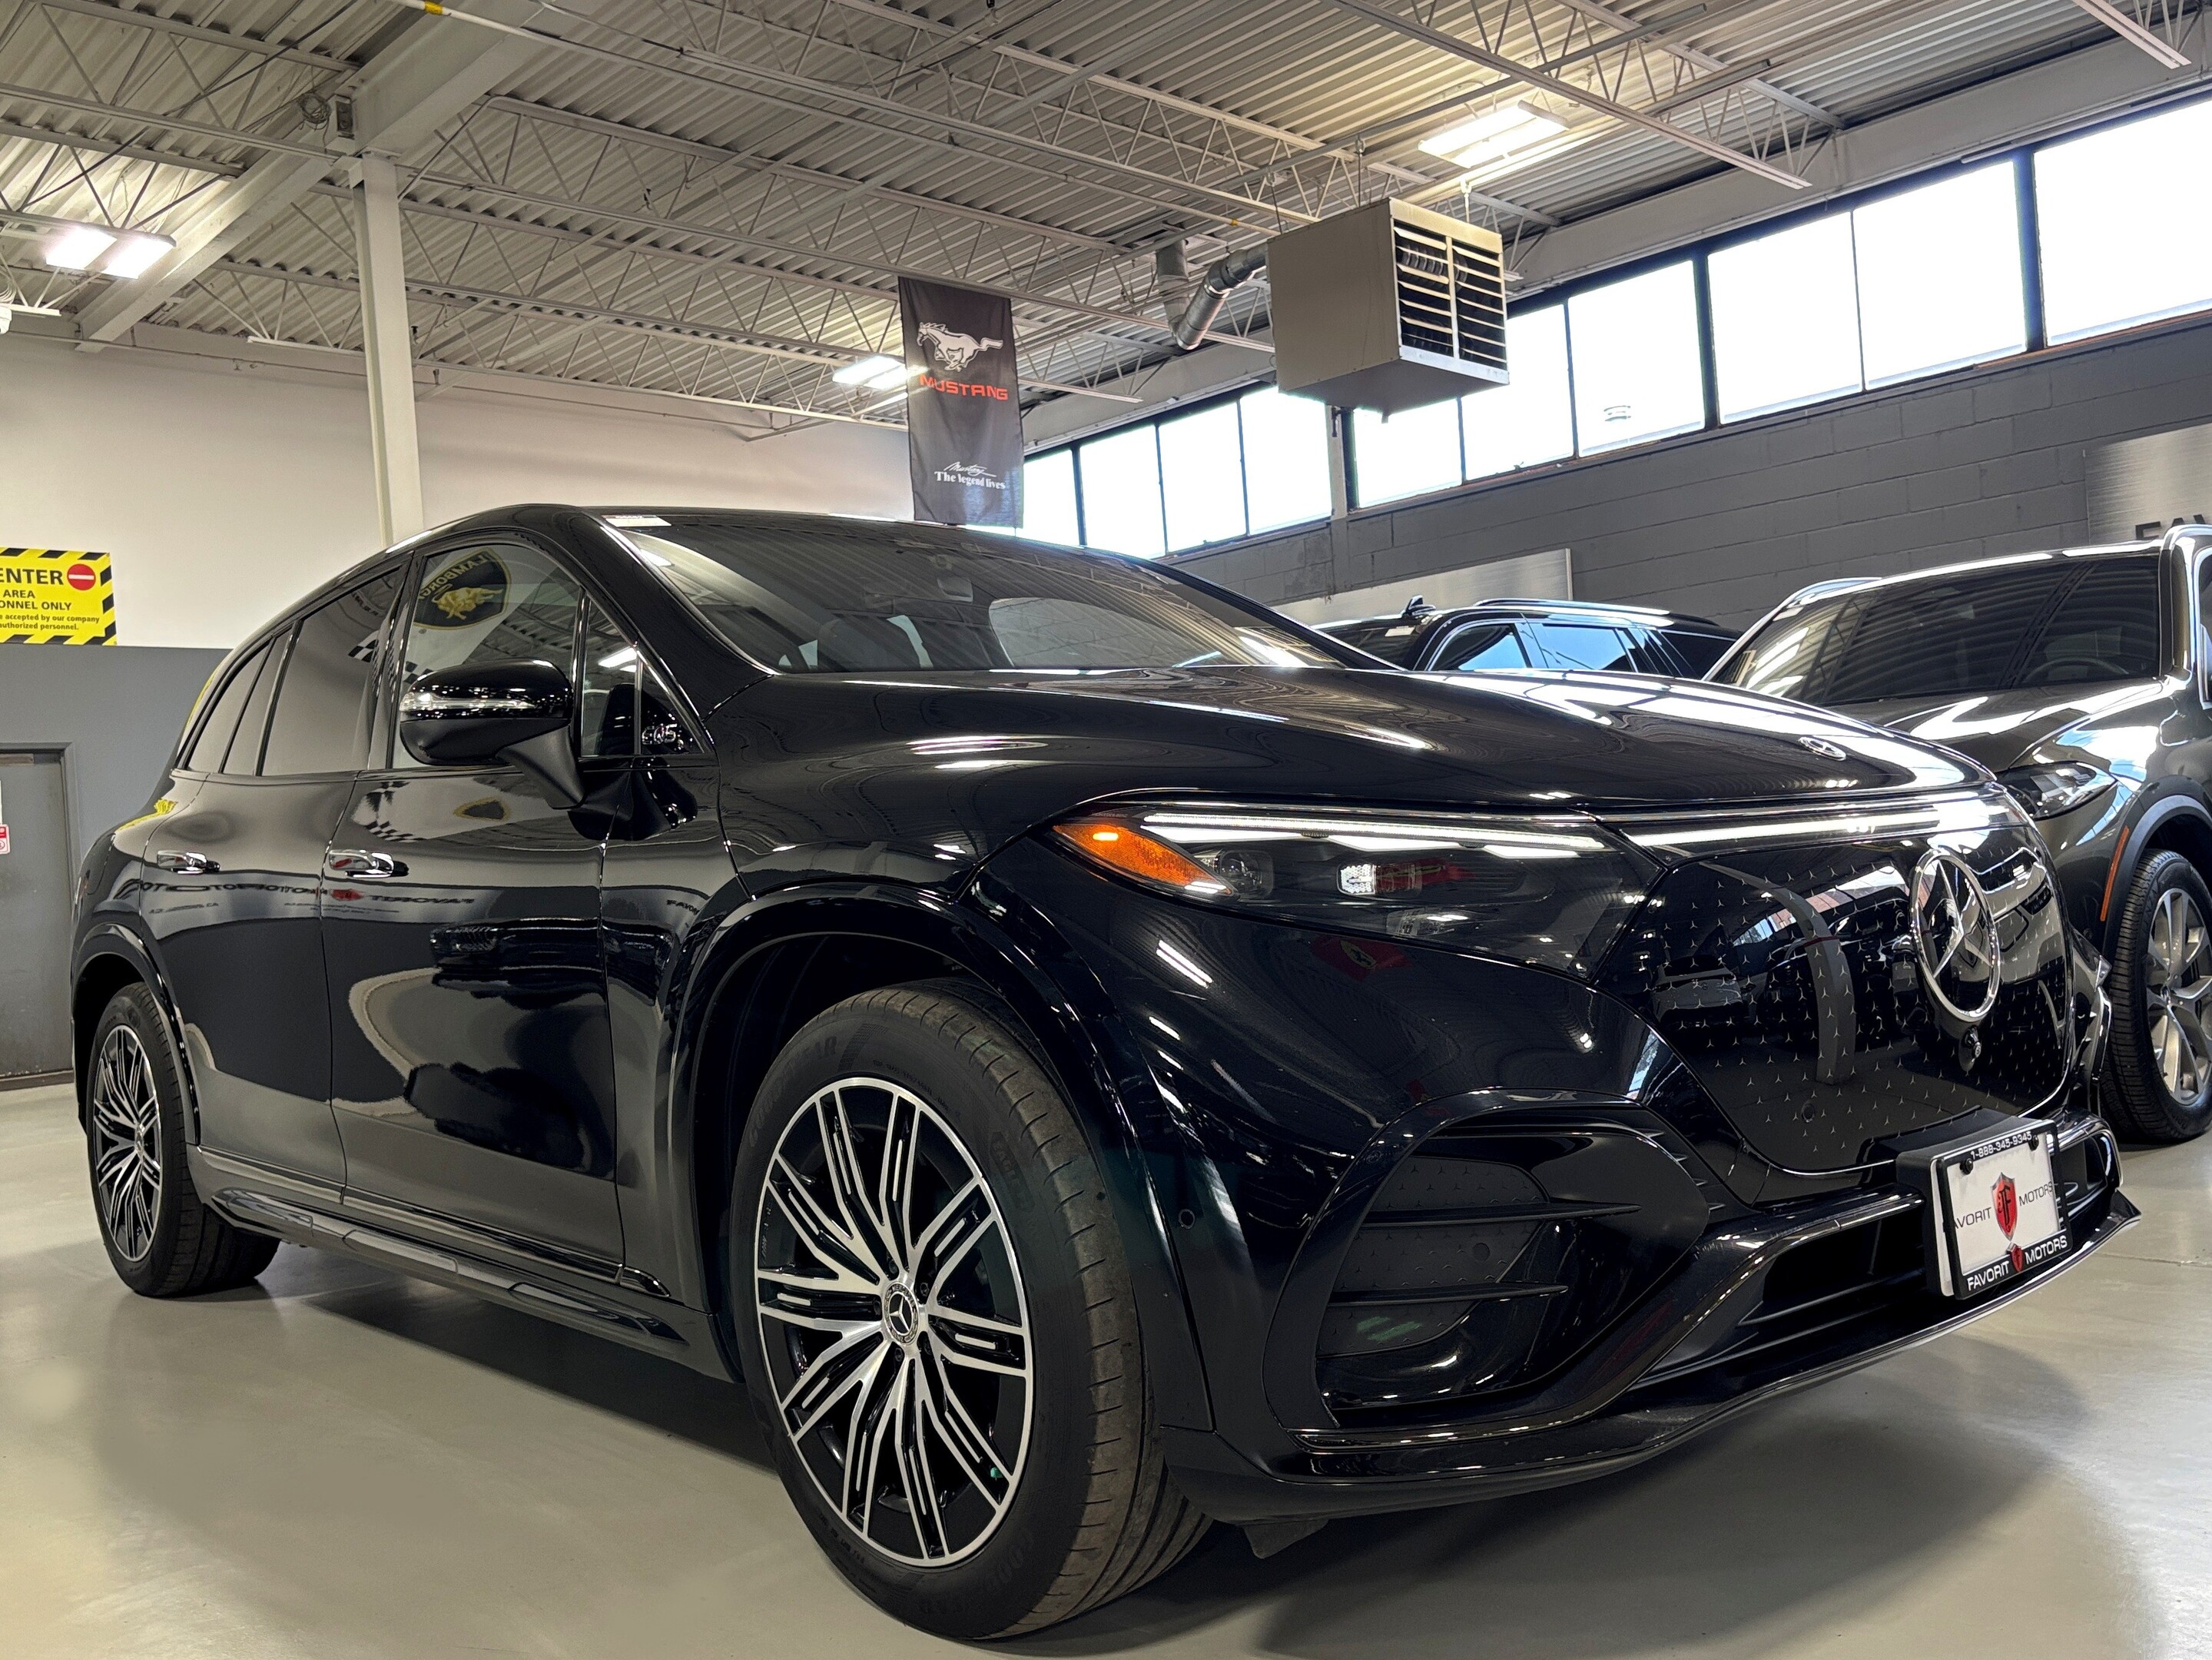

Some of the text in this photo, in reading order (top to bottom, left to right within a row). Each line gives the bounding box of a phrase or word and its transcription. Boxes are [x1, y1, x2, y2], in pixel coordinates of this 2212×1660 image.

[920, 374, 1008, 400] MUSTANG
[934, 471, 1007, 490] The legend lives
[3, 589, 36, 599] AREA
[41, 602, 72, 611] ONLY
[1970, 1130, 2033, 1160] 1-888-345-9345
[2018, 1180, 2054, 1207] MOTORS
[1967, 1260, 2010, 1291] FAVORIT
[2025, 1234, 2068, 1265] MOTORS
